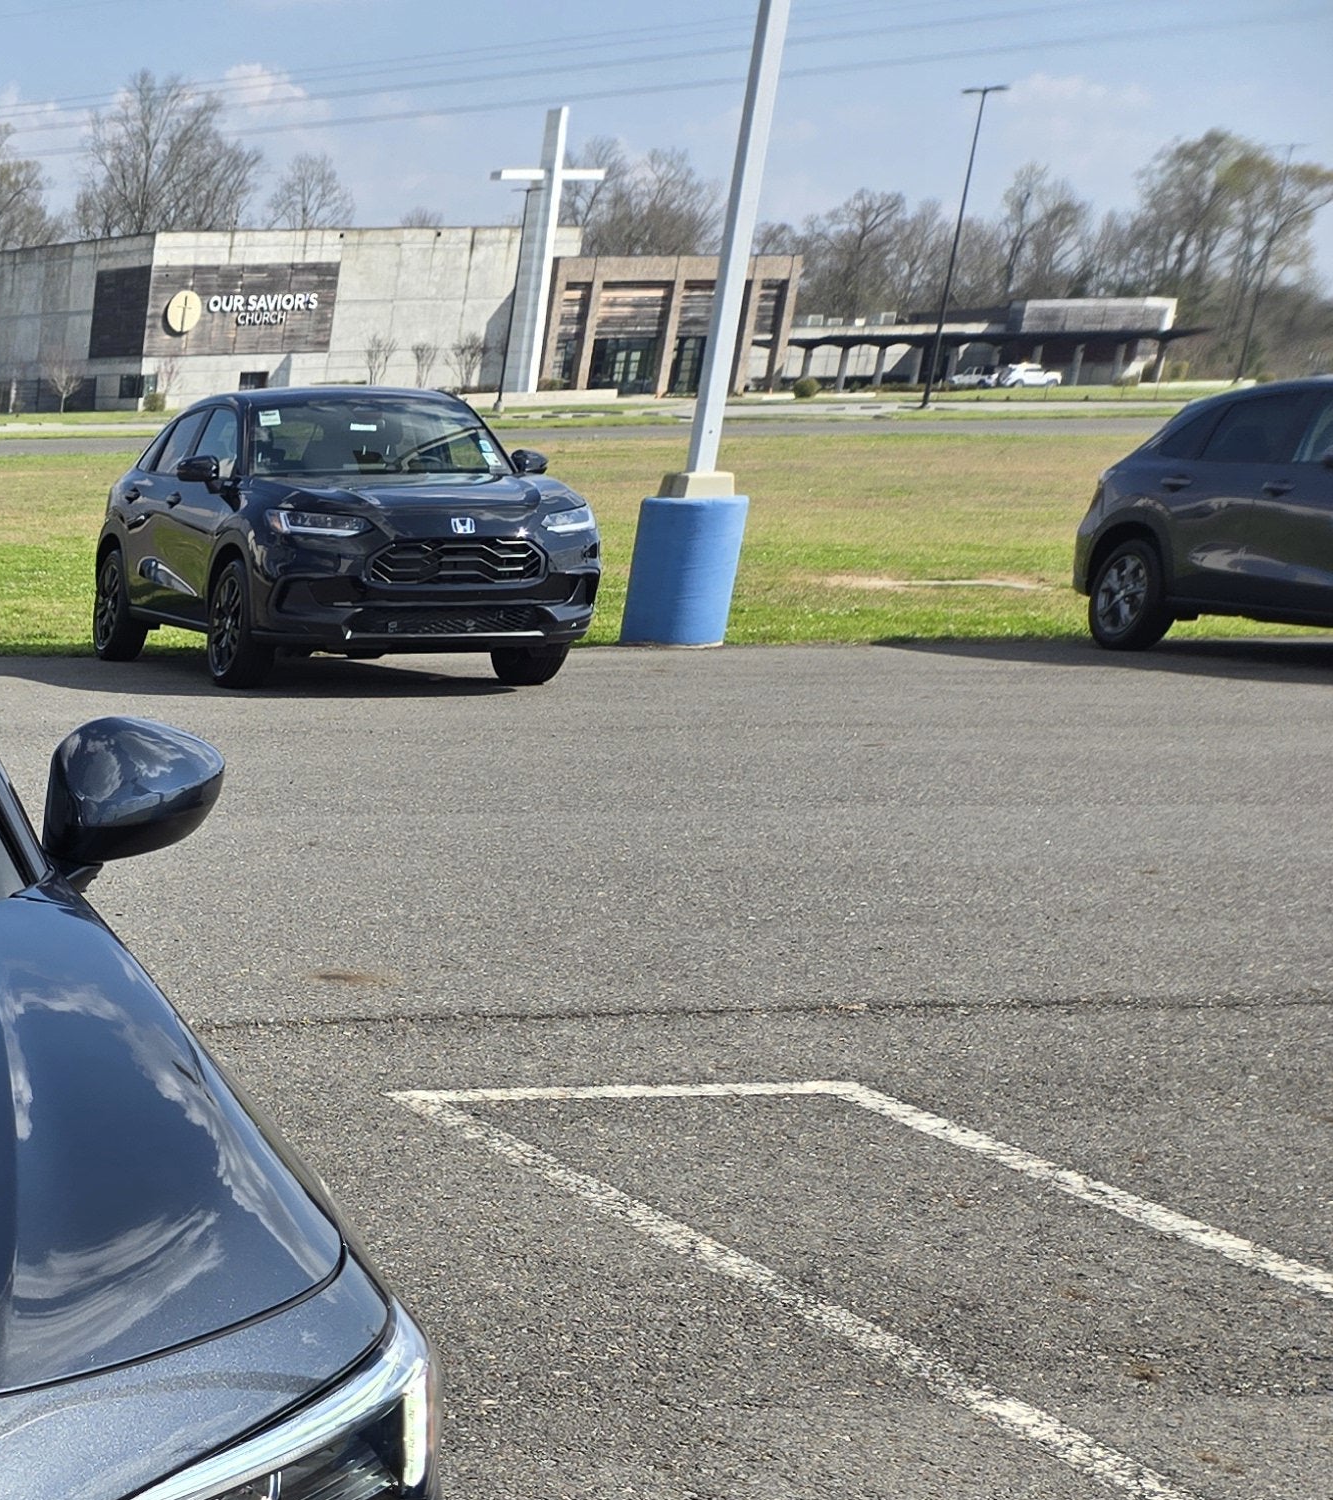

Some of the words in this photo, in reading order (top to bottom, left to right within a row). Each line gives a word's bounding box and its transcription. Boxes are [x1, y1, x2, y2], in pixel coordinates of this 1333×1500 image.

[208, 295, 244, 312] OUR
[248, 292, 319, 311] SAVIOR'S
[237, 311, 287, 326] CHURCH
